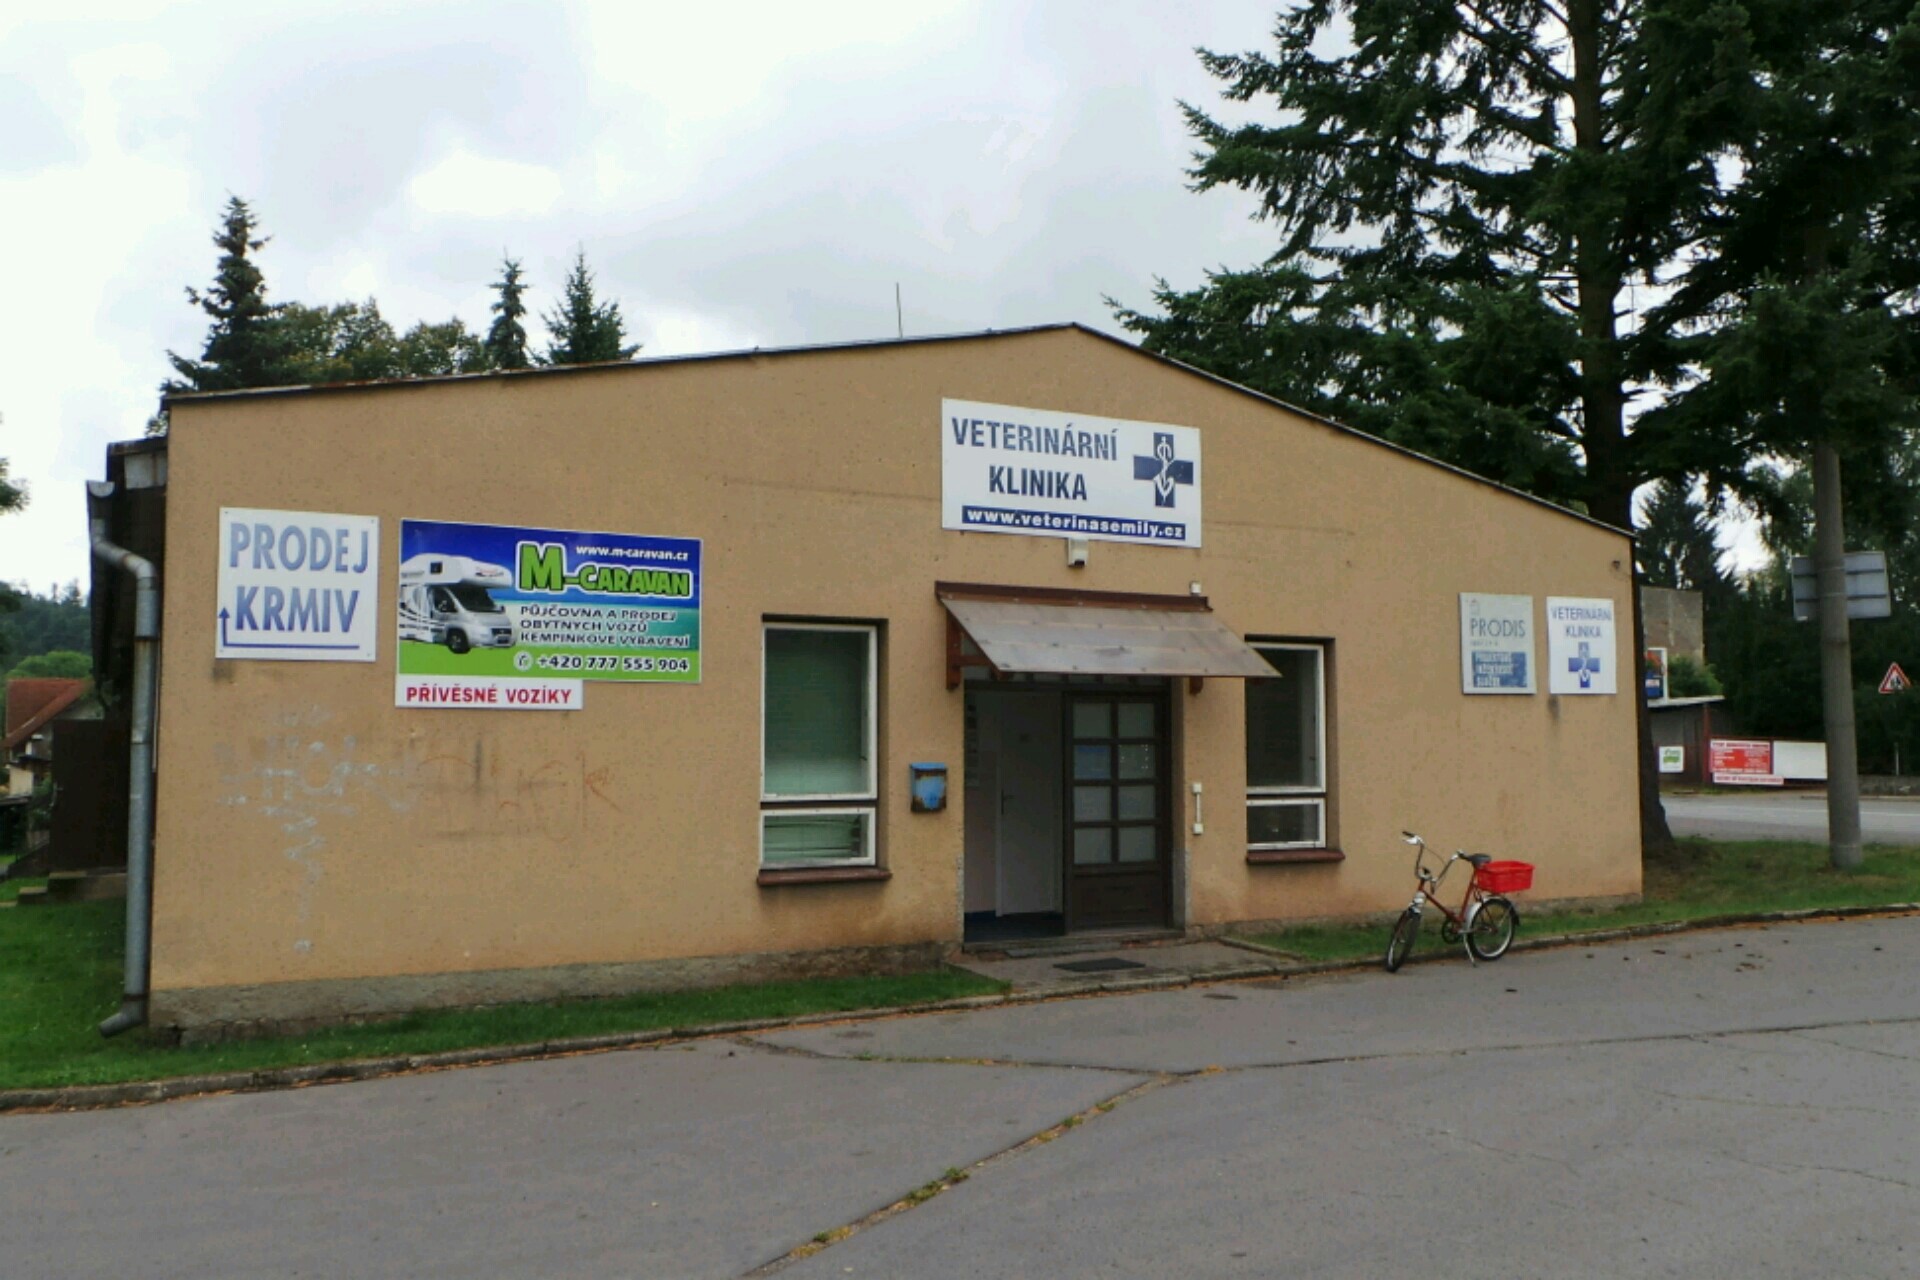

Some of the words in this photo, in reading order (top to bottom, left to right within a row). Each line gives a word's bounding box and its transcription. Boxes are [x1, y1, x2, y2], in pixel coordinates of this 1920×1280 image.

[951, 417, 1118, 461] VETERINÁRNÍ
[989, 465, 1088, 501] KLINIKA
[967, 509, 1183, 538] www.veterinasemily.cz
[229, 522, 369, 574] PRODEJ
[576, 545, 689, 561] www.m-caravan.cz
[235, 585, 360, 633] KRMIV
[520, 603, 602, 619] PŮJČOVNA
[606, 610, 617, 619] A
[621, 609, 676, 621] PRODEJ
[1470, 617, 1526, 638] PRODIS
[1565, 625, 1602, 638] KLINIKA
[538, 656, 582, 669] +420
[587, 657, 618, 669] 777
[622, 658, 653, 671] 555
[658, 659, 689, 672] 904
[406, 683, 498, 703] PŘÍVĚSNÉ
[506, 685, 572, 704] VOZÍKY
